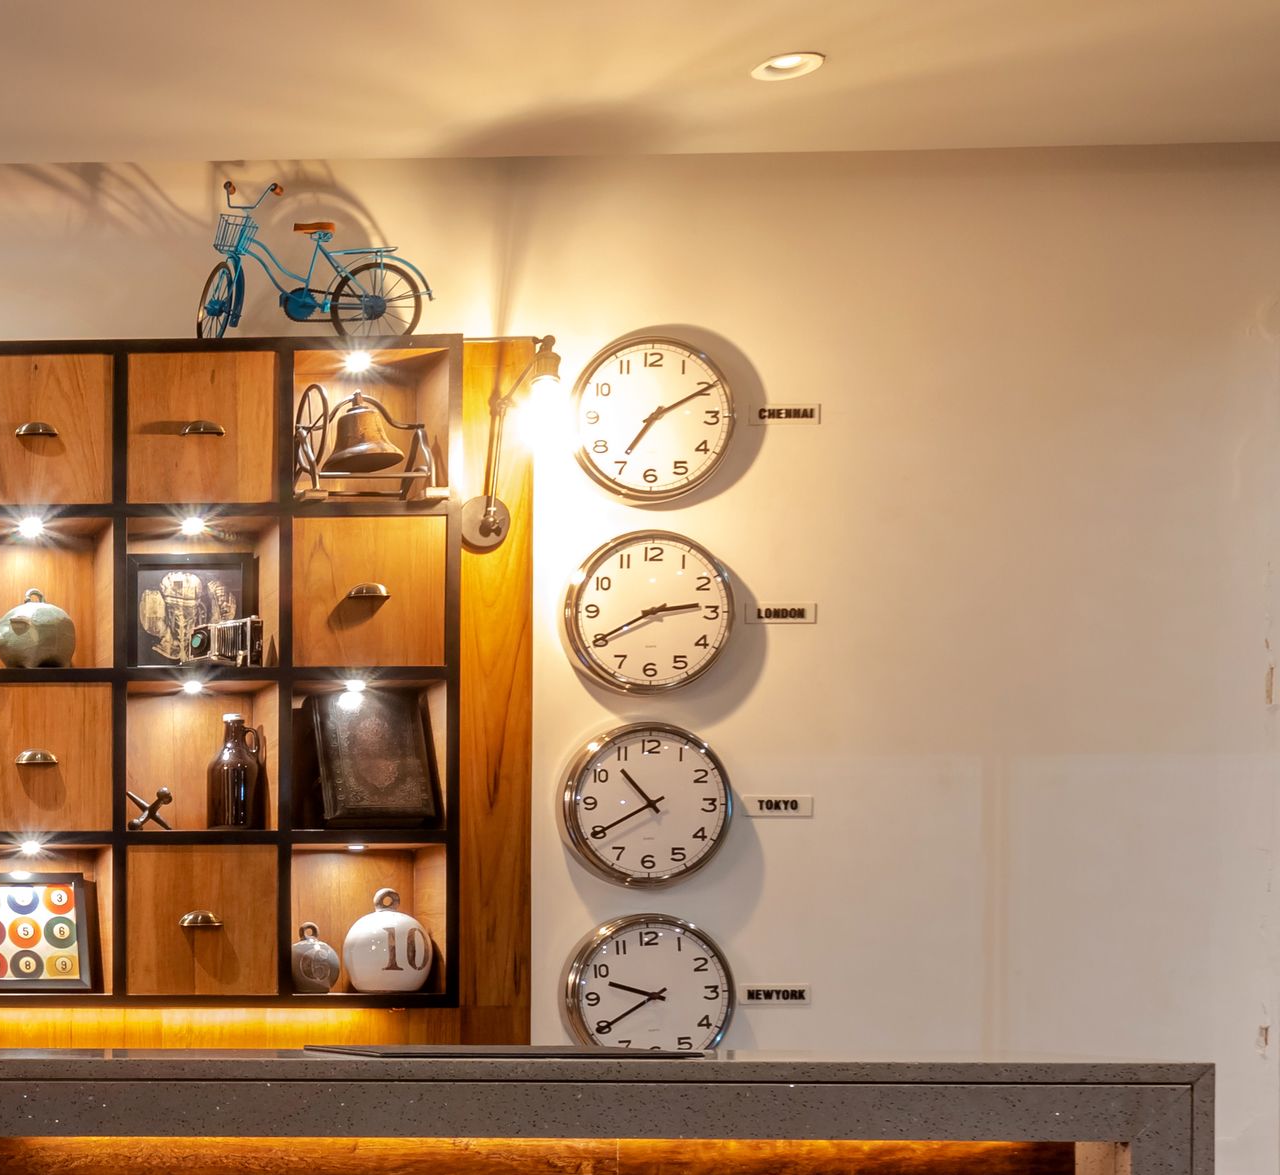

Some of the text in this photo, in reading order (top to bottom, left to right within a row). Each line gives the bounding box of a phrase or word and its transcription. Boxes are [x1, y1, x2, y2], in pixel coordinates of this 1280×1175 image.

[619, 359, 631, 375] 11
[643, 352, 664, 368] 12
[595, 382, 612, 397] 10
[696, 381, 711, 396] 2
[586, 410, 600, 425] 9
[703, 410, 720, 425] 3
[757, 408, 814, 420] CHENNAI
[593, 440, 608, 454] 8
[695, 439, 710, 455] 4
[614, 461, 627, 476] 7
[673, 460, 688, 476] 5
[642, 469, 657, 483] 6
[619, 554, 631, 569] 11
[643, 547, 664, 562] 12
[595, 576, 612, 591] 10
[696, 576, 711, 591] 2
[585, 604, 600, 619] 9
[703, 605, 720, 621] 3
[756, 608, 805, 619] LONDON
[593, 633, 609, 648] 8
[694, 634, 710, 649] 4
[614, 654, 627, 670] 7
[642, 662, 657, 677] 6
[673, 655, 688, 670] 5
[616, 746, 628, 762] 11
[641, 739, 662, 754] 12
[593, 768, 609, 783] 10
[693, 769, 709, 784] 2
[583, 796, 598, 811] 9
[701, 797, 718, 813] 3
[757, 799, 800, 811] TOKYO
[591, 824, 607, 840] 8
[692, 827, 708, 841] 4
[612, 846, 626, 861] 7
[670, 847, 686, 862] 5
[640, 854, 656, 869] 6
[56, 893, 63, 903] 3
[22, 927, 29, 936] 5
[58, 926, 65, 936] 6
[639, 931, 659, 946] 12
[382, 927, 430, 971] 10
[614, 939, 627, 955] 11
[24, 960, 31, 970] 8
[60, 960, 67, 970] 9
[593, 964, 610, 979] 10
[693, 957, 709, 972] 2
[585, 991, 600, 1006] 9
[703, 985, 720, 1001] 3
[747, 989, 807, 1001] NEWYORK
[595, 1020, 612, 1034] 8
[697, 1015, 712, 1030] 4
[677, 1037, 693, 1050] 5
